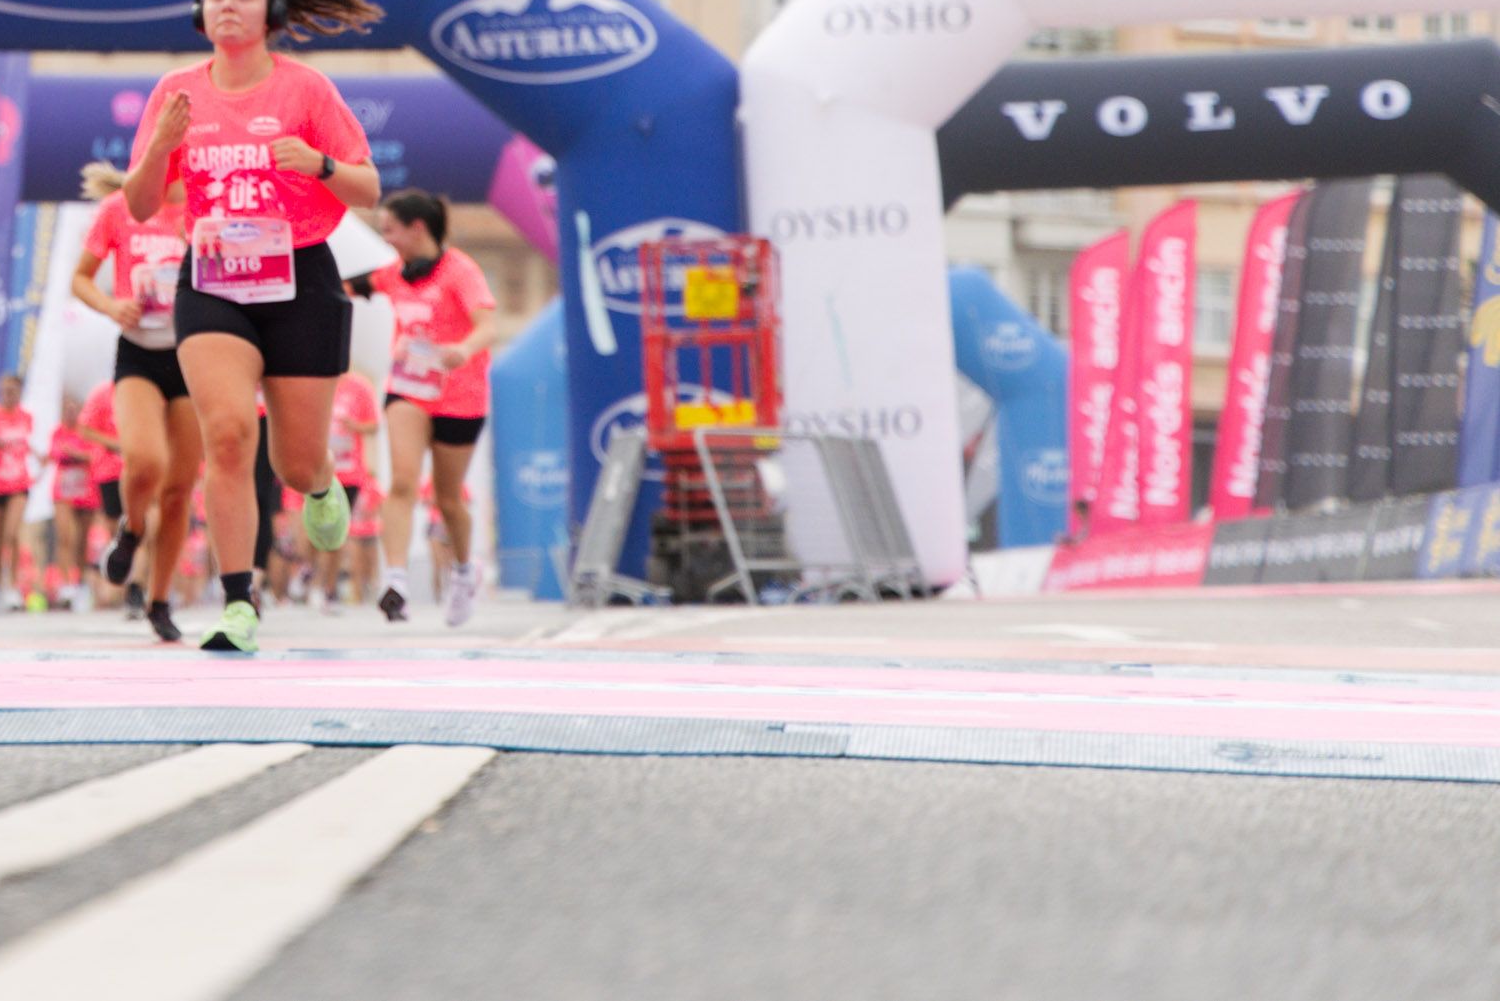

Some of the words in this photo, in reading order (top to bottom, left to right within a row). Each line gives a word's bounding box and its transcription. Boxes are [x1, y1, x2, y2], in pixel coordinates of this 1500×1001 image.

[453, 20, 646, 61] ASTURIANA
[1004, 79, 1412, 141] VOLVO
[187, 143, 272, 173] CARRERA
[771, 203, 910, 246] OYSHO
[223, 256, 262, 274] 016
